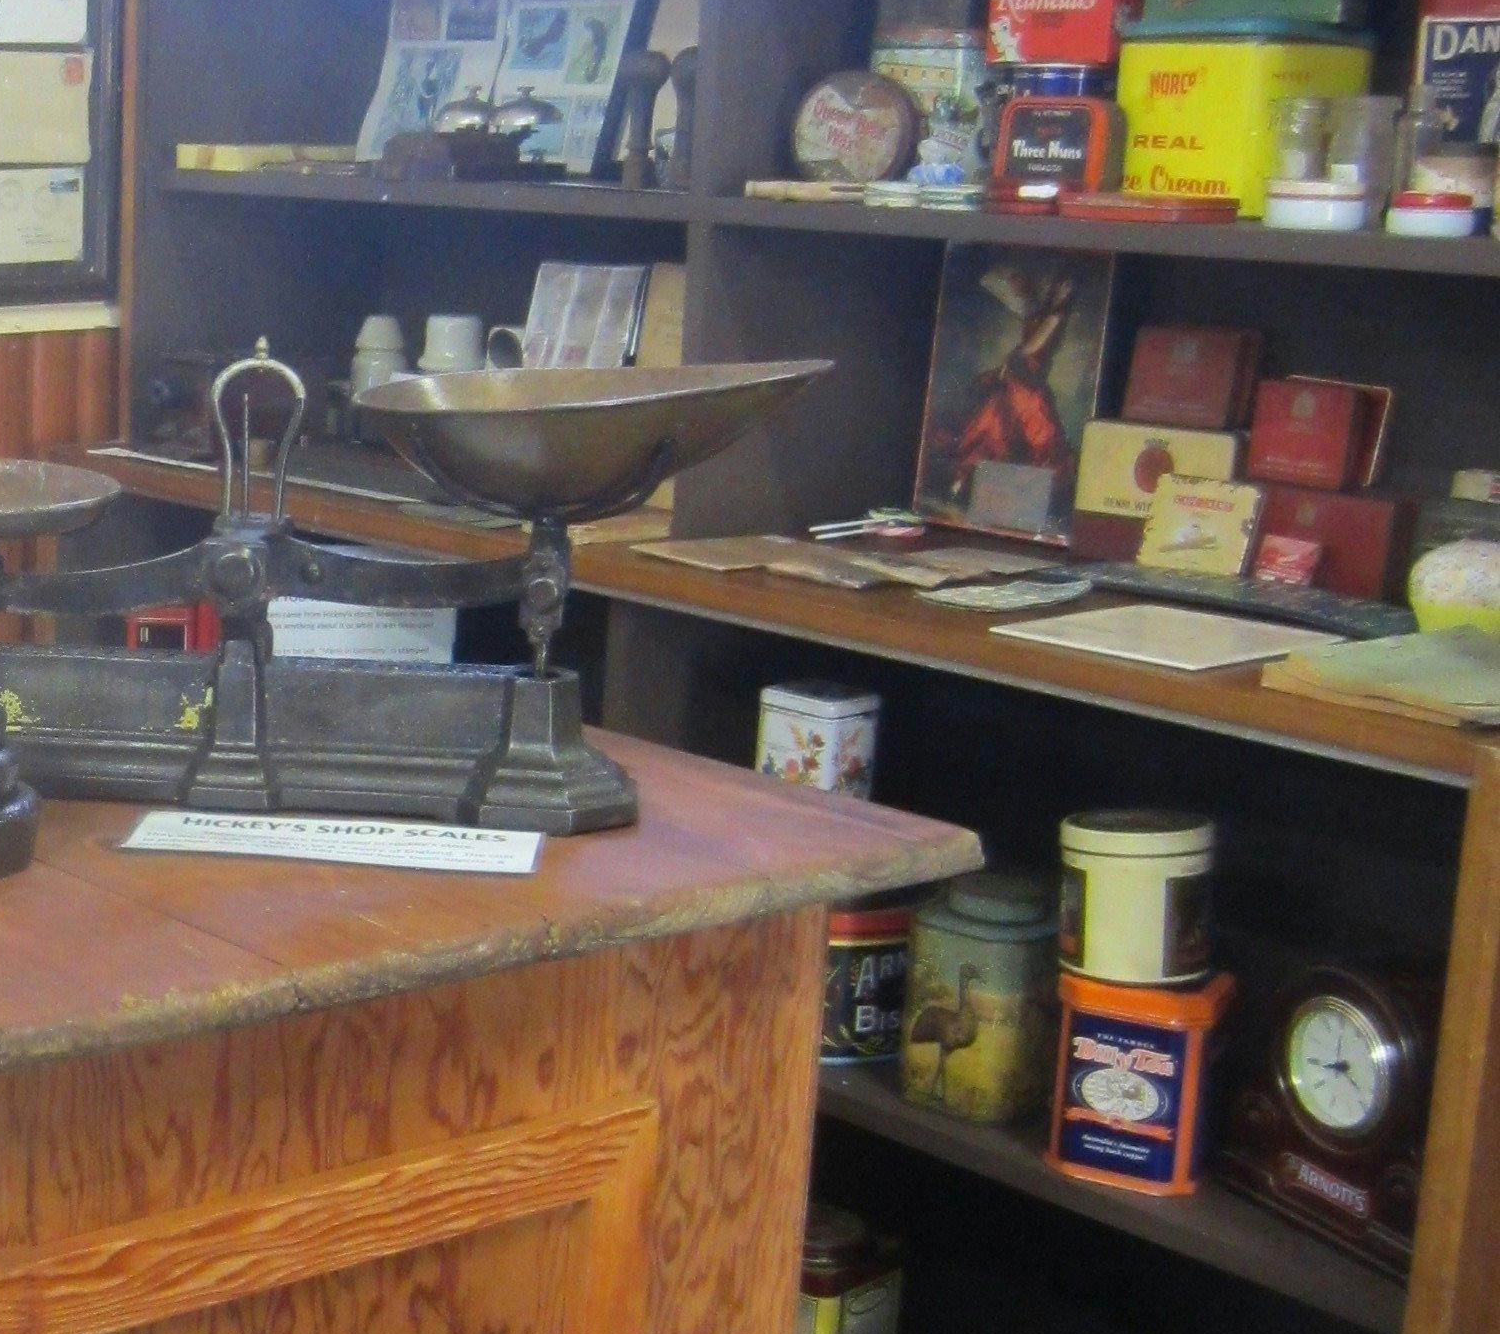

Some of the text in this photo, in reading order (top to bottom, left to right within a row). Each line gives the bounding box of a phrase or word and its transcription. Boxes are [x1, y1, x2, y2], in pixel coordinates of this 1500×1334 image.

[1133, 134, 1205, 151] REAL
[1150, 164, 1232, 195] Cream
[182, 814, 509, 843] HICKEY'S SHOP SCALES
